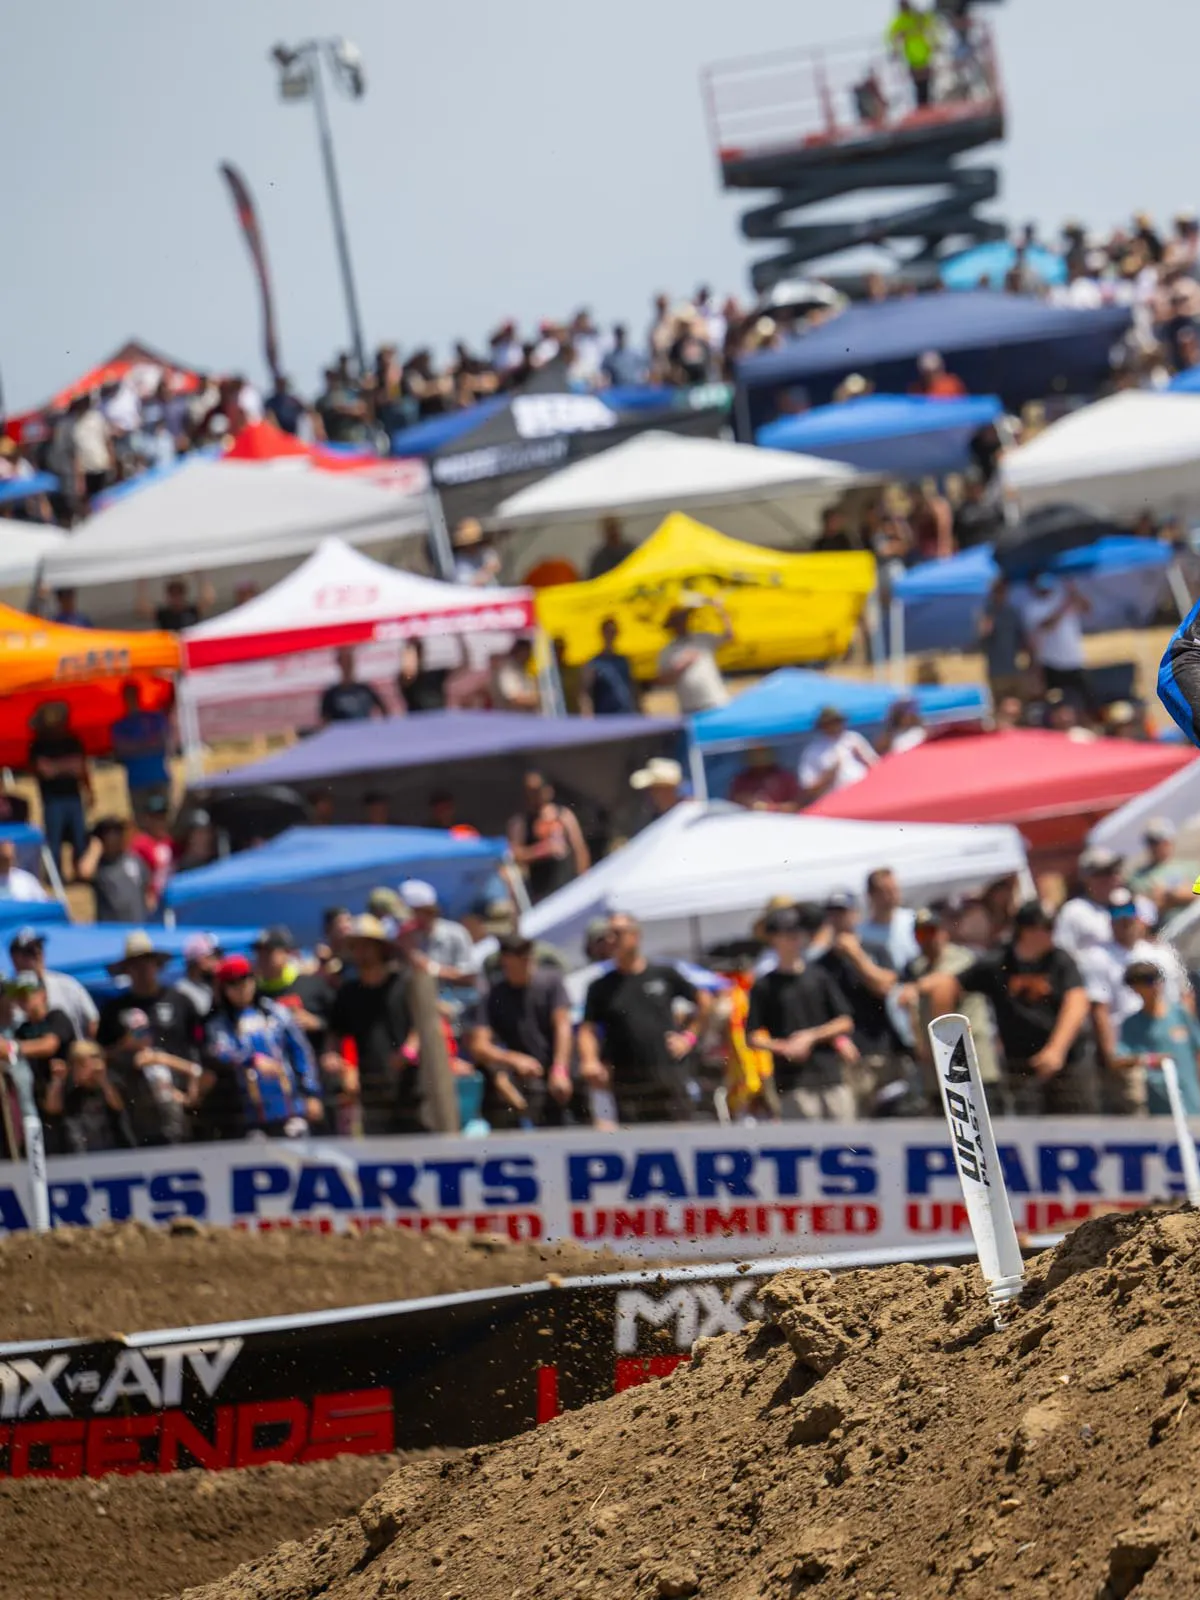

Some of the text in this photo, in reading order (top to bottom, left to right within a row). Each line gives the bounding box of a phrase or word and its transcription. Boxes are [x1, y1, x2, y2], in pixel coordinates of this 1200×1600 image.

[945, 1087, 982, 1183] UFO
[232, 1157, 539, 1213] PARTS
[567, 1148, 878, 1202] PARTS
[572, 1202, 880, 1239] UNLIMITED
[93, 1337, 245, 1412] ATV
[0, 1388, 394, 1480] GENDS
